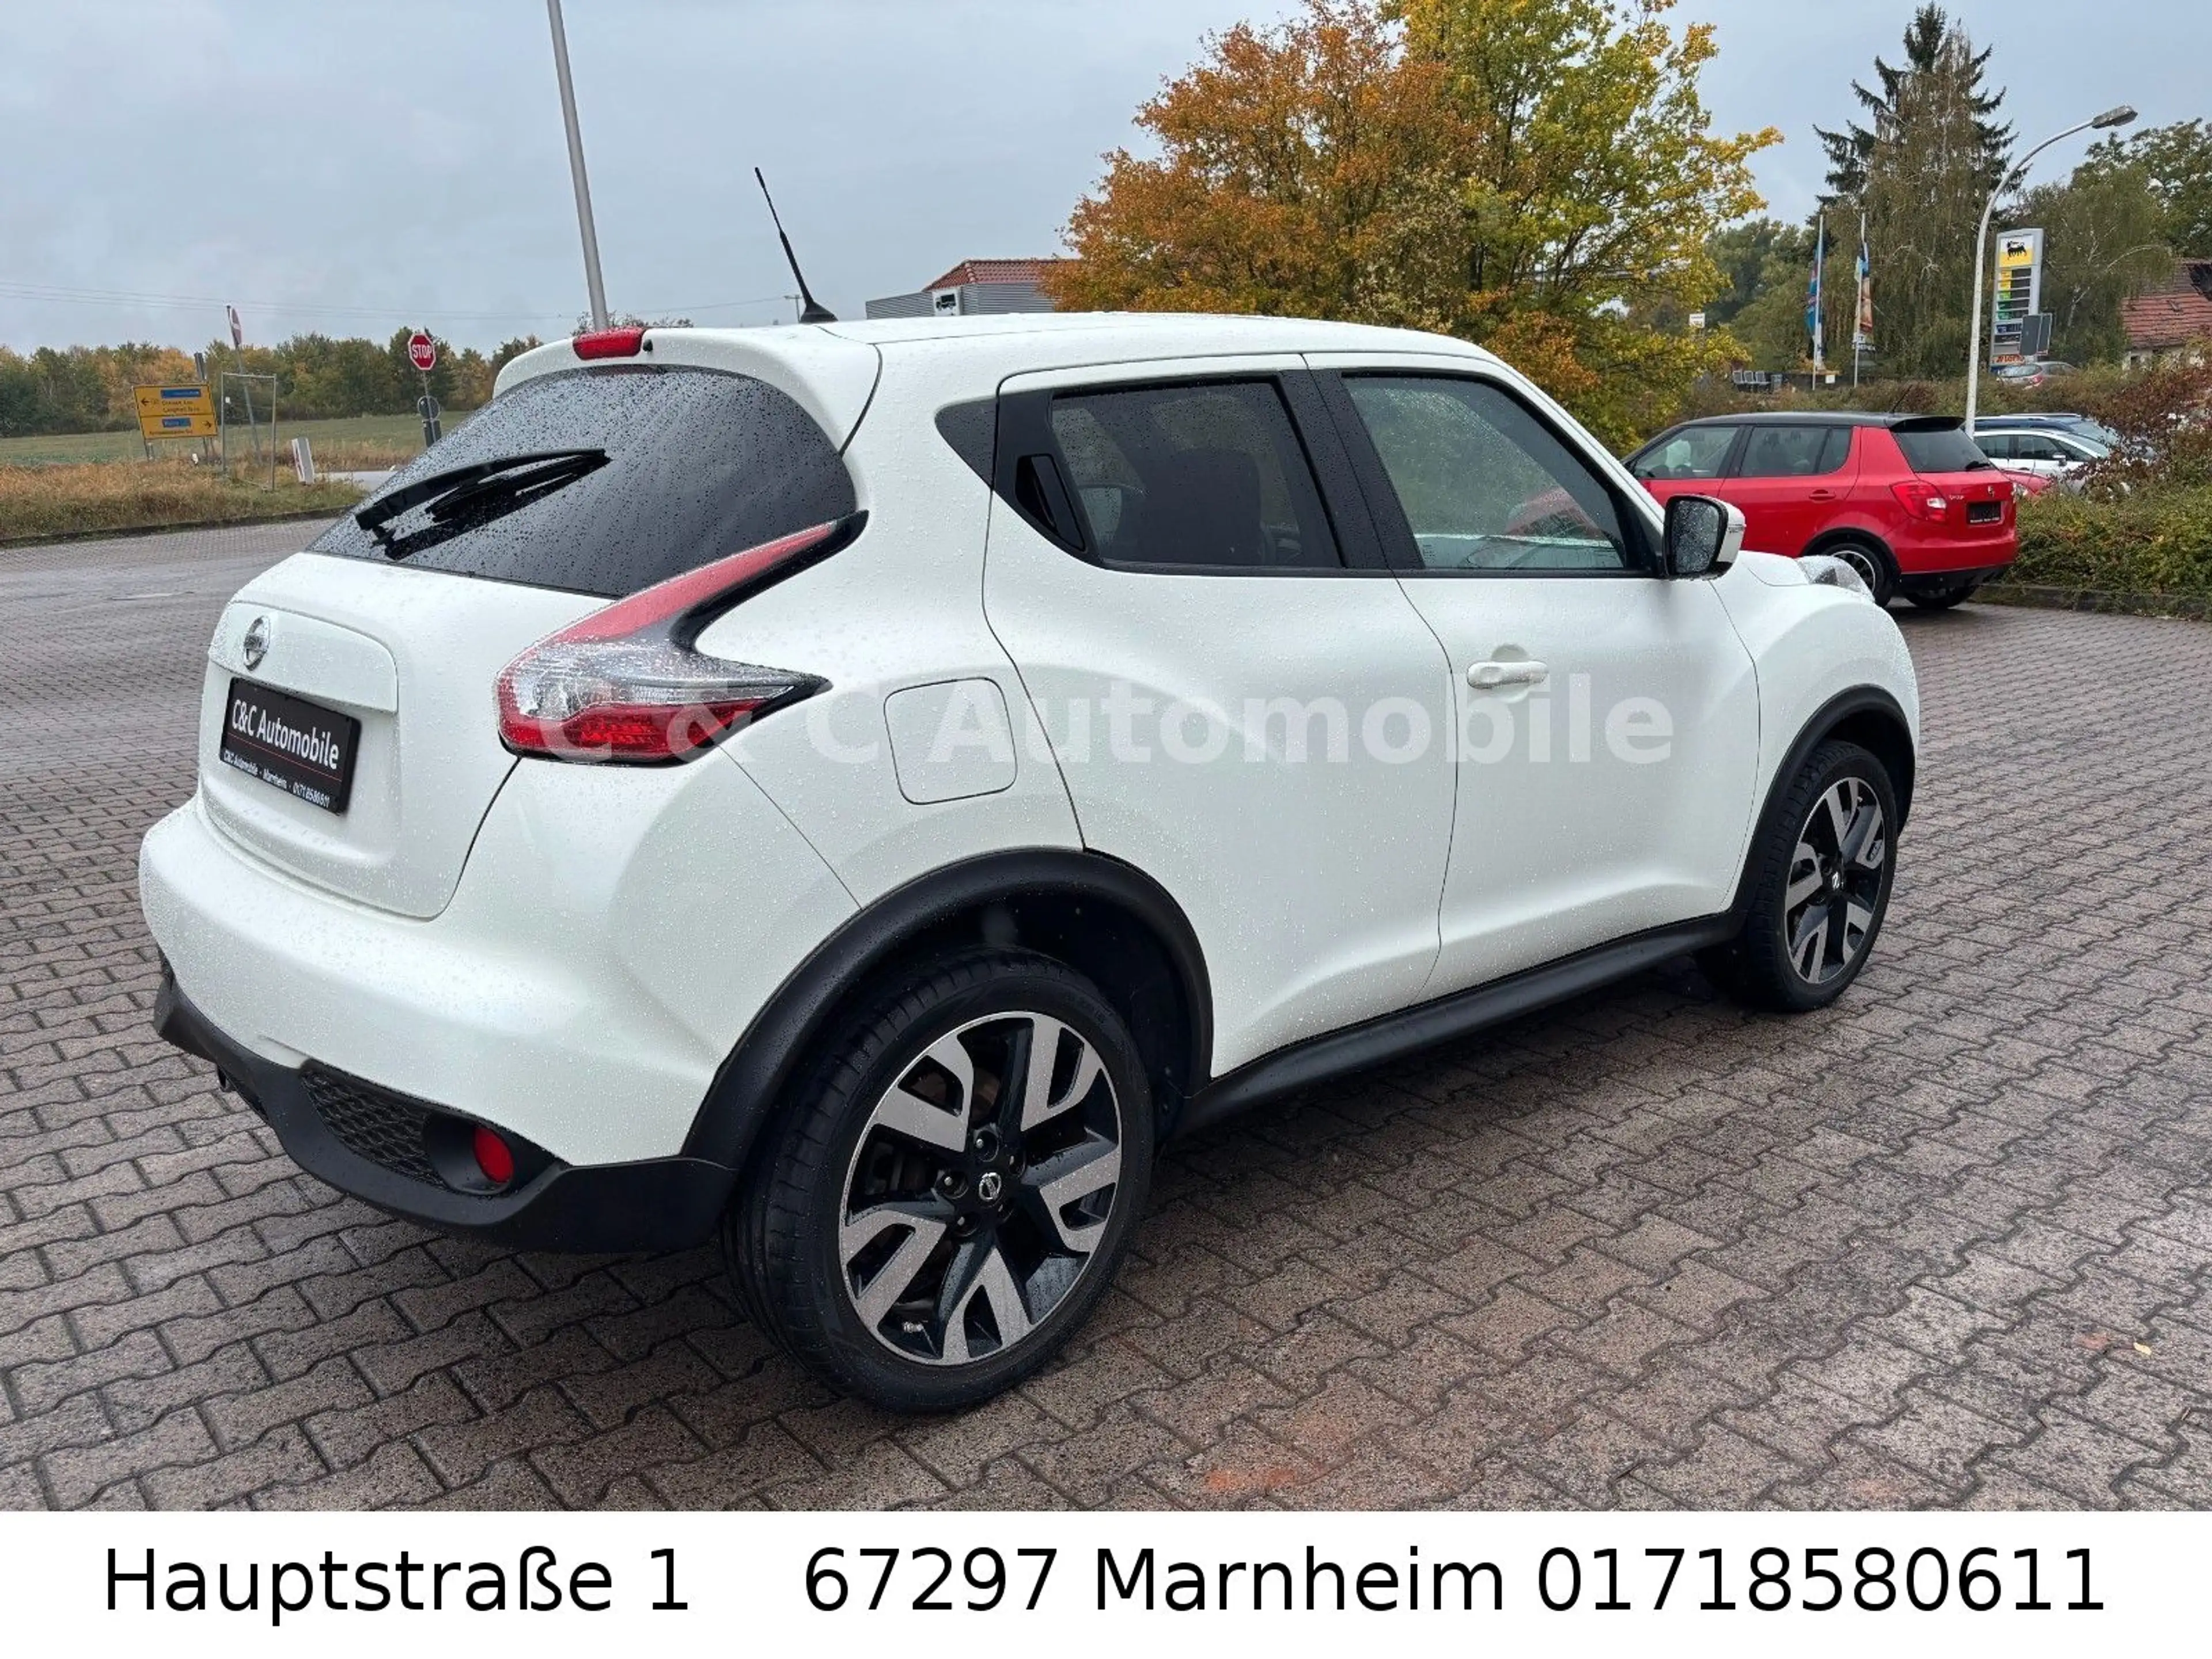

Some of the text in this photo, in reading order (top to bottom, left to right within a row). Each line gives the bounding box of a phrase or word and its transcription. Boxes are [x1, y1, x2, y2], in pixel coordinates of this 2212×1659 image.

[412, 344, 433, 358] STOP
[232, 699, 340, 770] C&C Automobile
